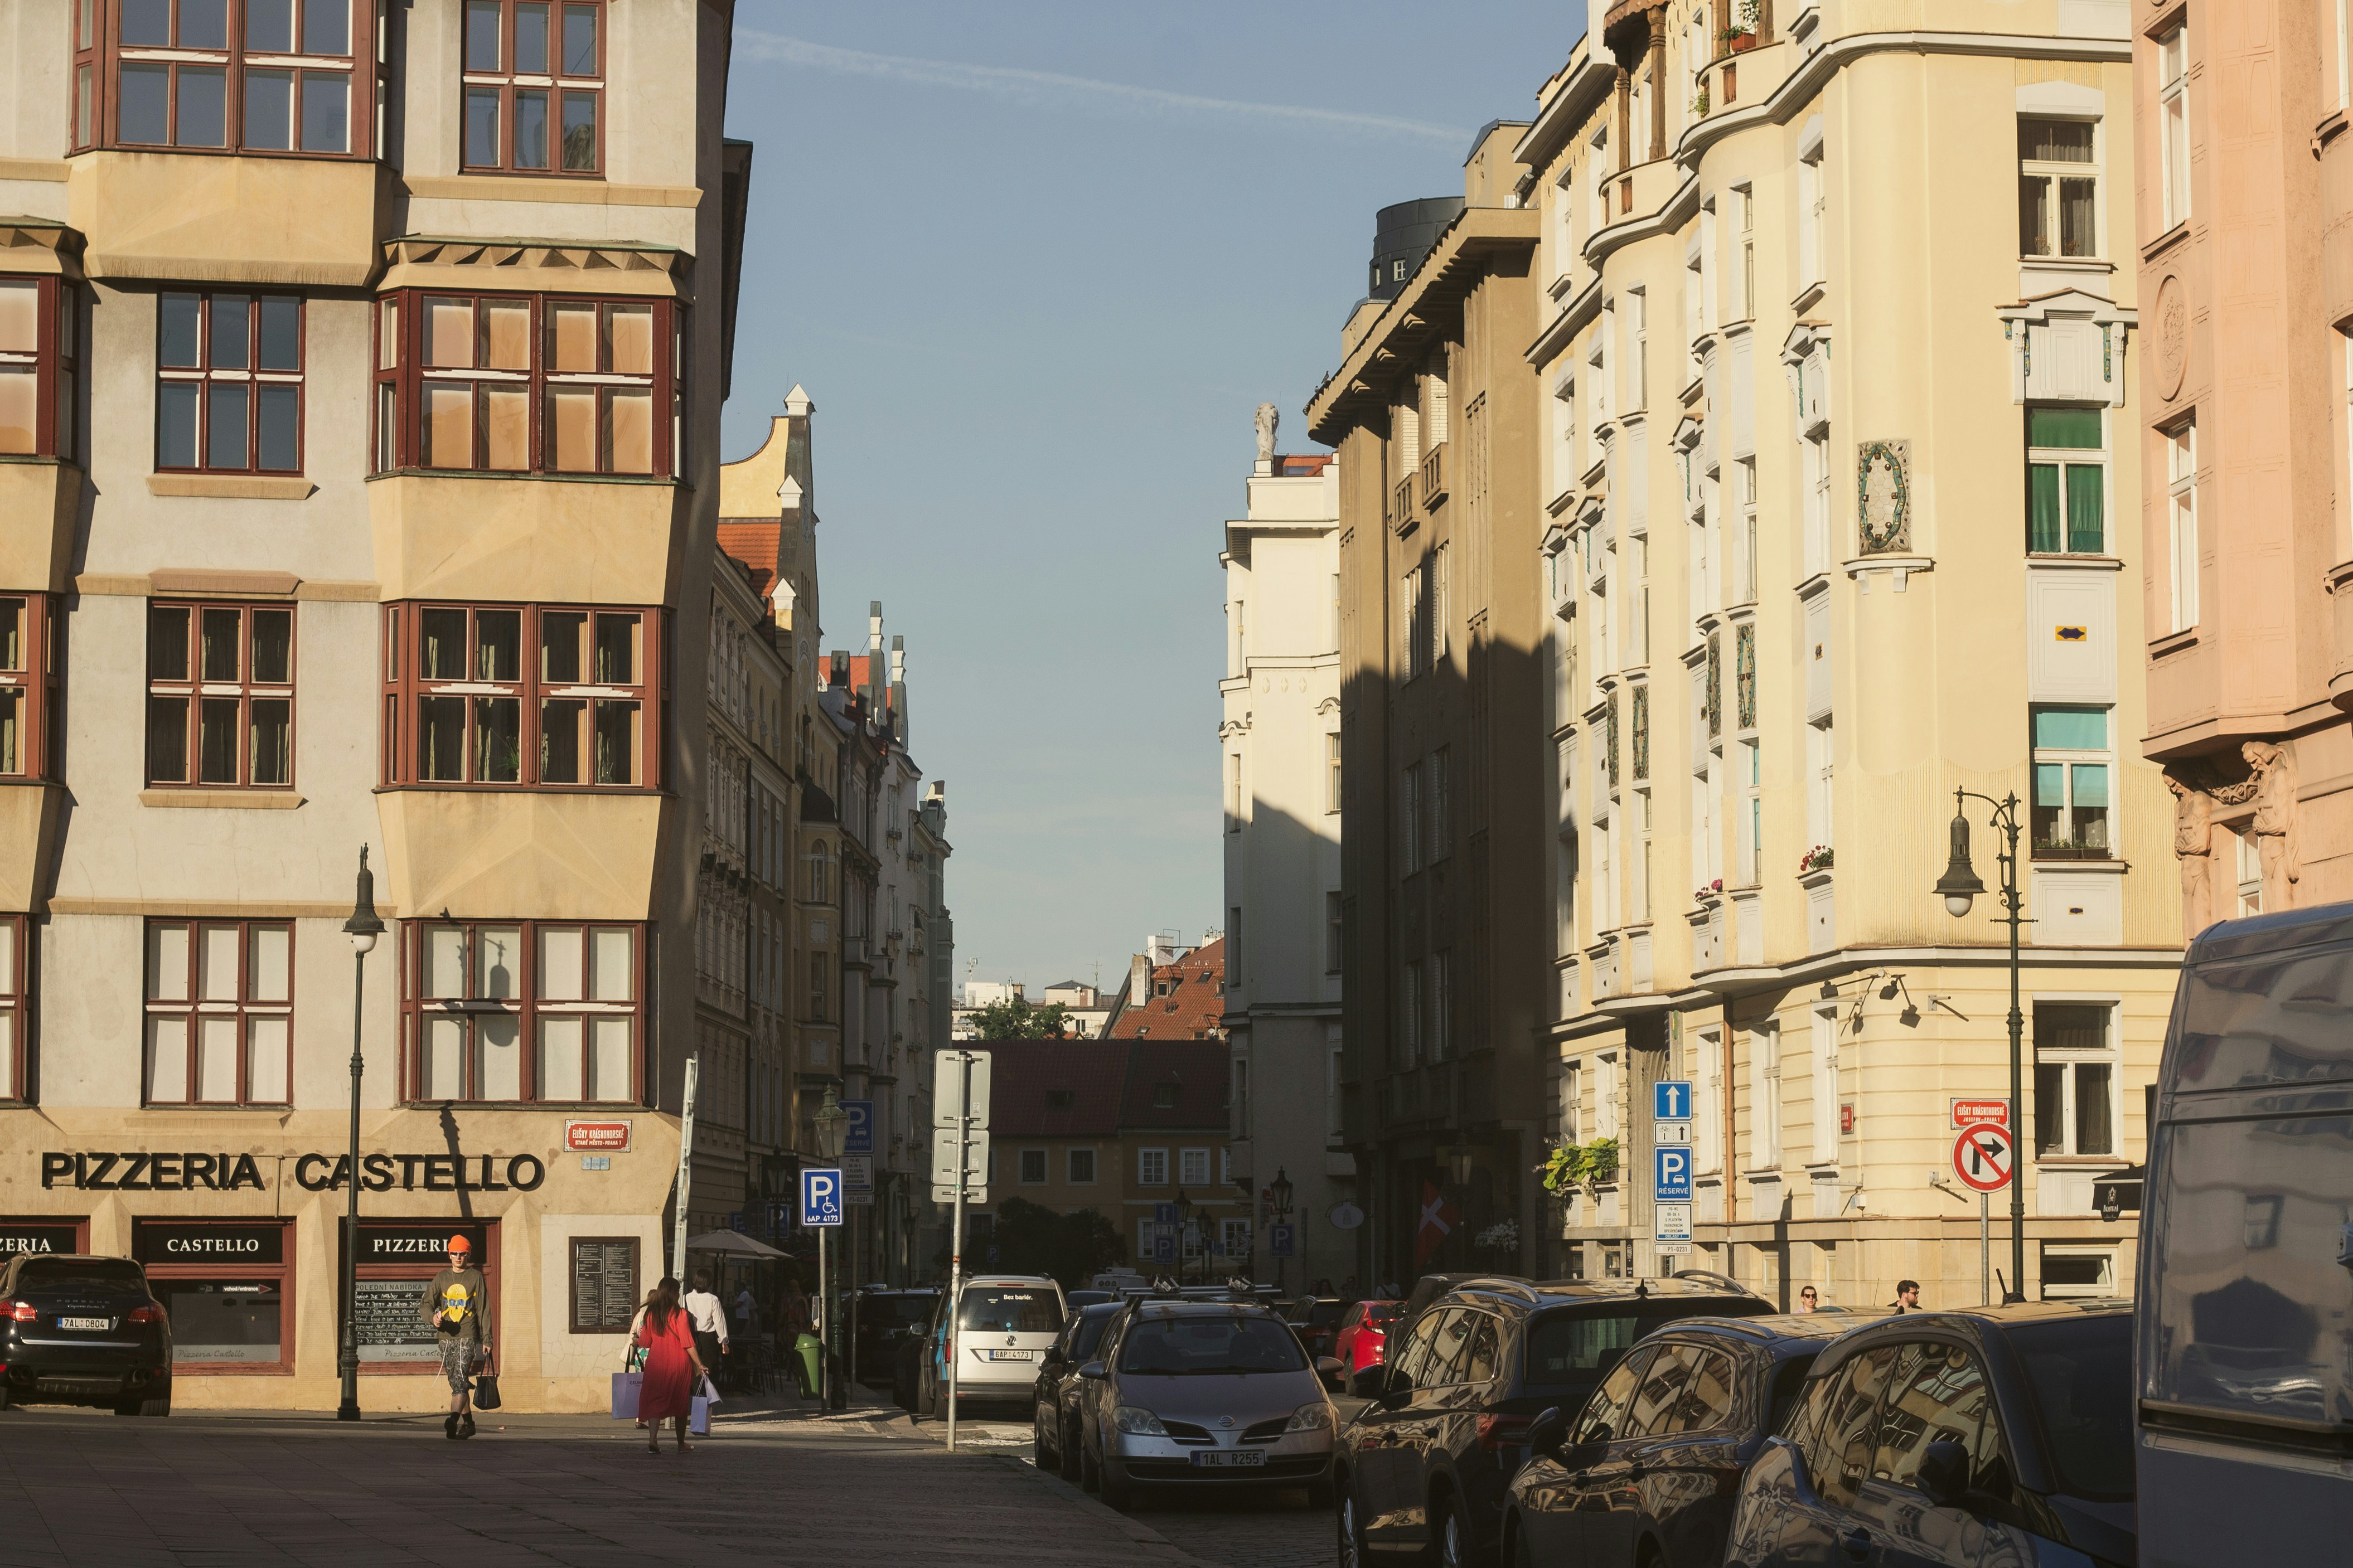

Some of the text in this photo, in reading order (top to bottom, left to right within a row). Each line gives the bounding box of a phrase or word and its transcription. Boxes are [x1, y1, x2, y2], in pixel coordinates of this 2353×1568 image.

[1957, 1105, 2005, 1115] ELIŠKY KRÁSNOHORSKÉ
[845, 1106, 866, 1136] P
[572, 1127, 624, 1139] ELIŠKY KRÁSNOHORSKÉ
[42, 1152, 544, 1191] PIZZERIA CASTELLO
[1663, 1153, 1684, 1184] P
[811, 1176, 833, 1208] P
[1275, 1229, 1289, 1247] P
[167, 1239, 259, 1251] CASTELLO
[374, 1239, 448, 1252] PIZZERI
[1159, 1240, 1170, 1255] P
[989, 1247, 998, 1258] P
[64, 1319, 104, 1328] 7AL 0804
[1203, 1453, 1258, 1465] 1AL R255
